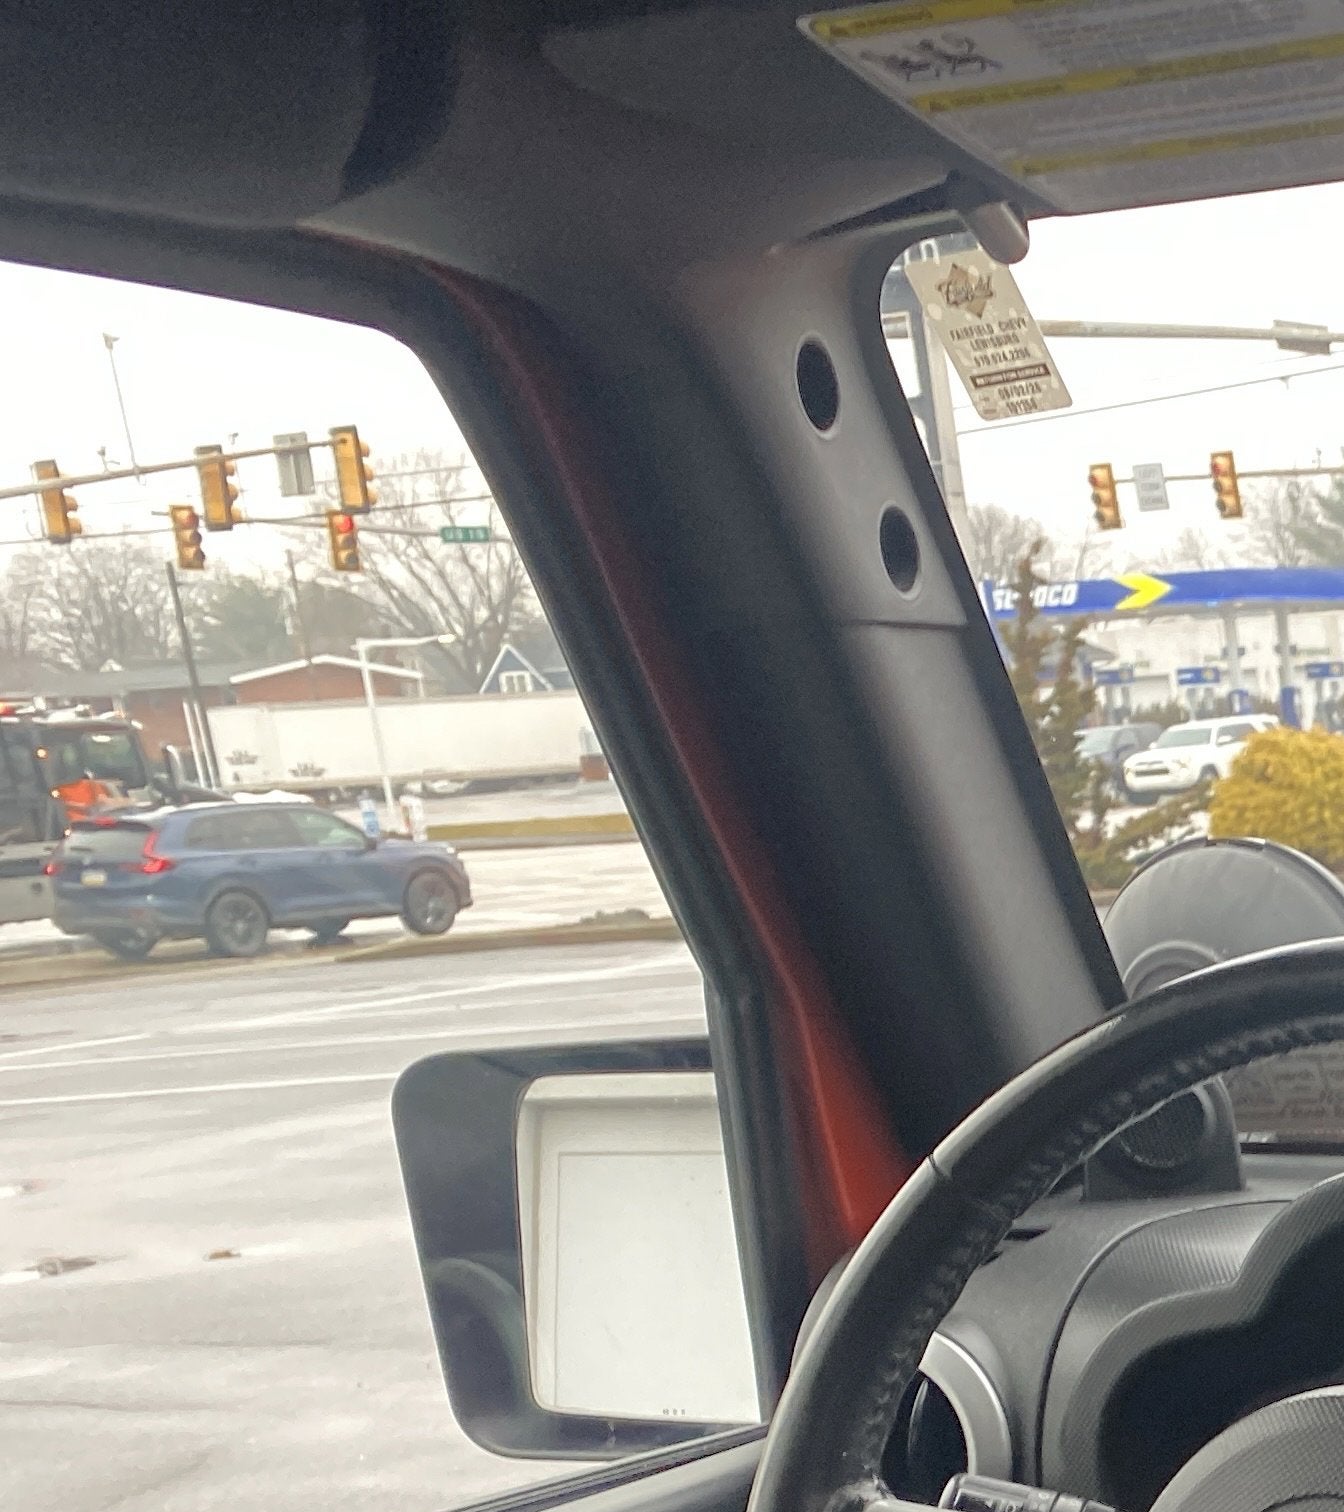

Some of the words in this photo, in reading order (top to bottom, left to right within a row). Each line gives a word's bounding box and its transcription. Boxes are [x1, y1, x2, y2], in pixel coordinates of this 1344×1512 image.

[949, 322, 994, 341] FAIRFIELD
[998, 316, 1027, 332] CHEVY
[969, 332, 1020, 351] LEWISBURG
[992, 583, 1079, 611] SUOCO
